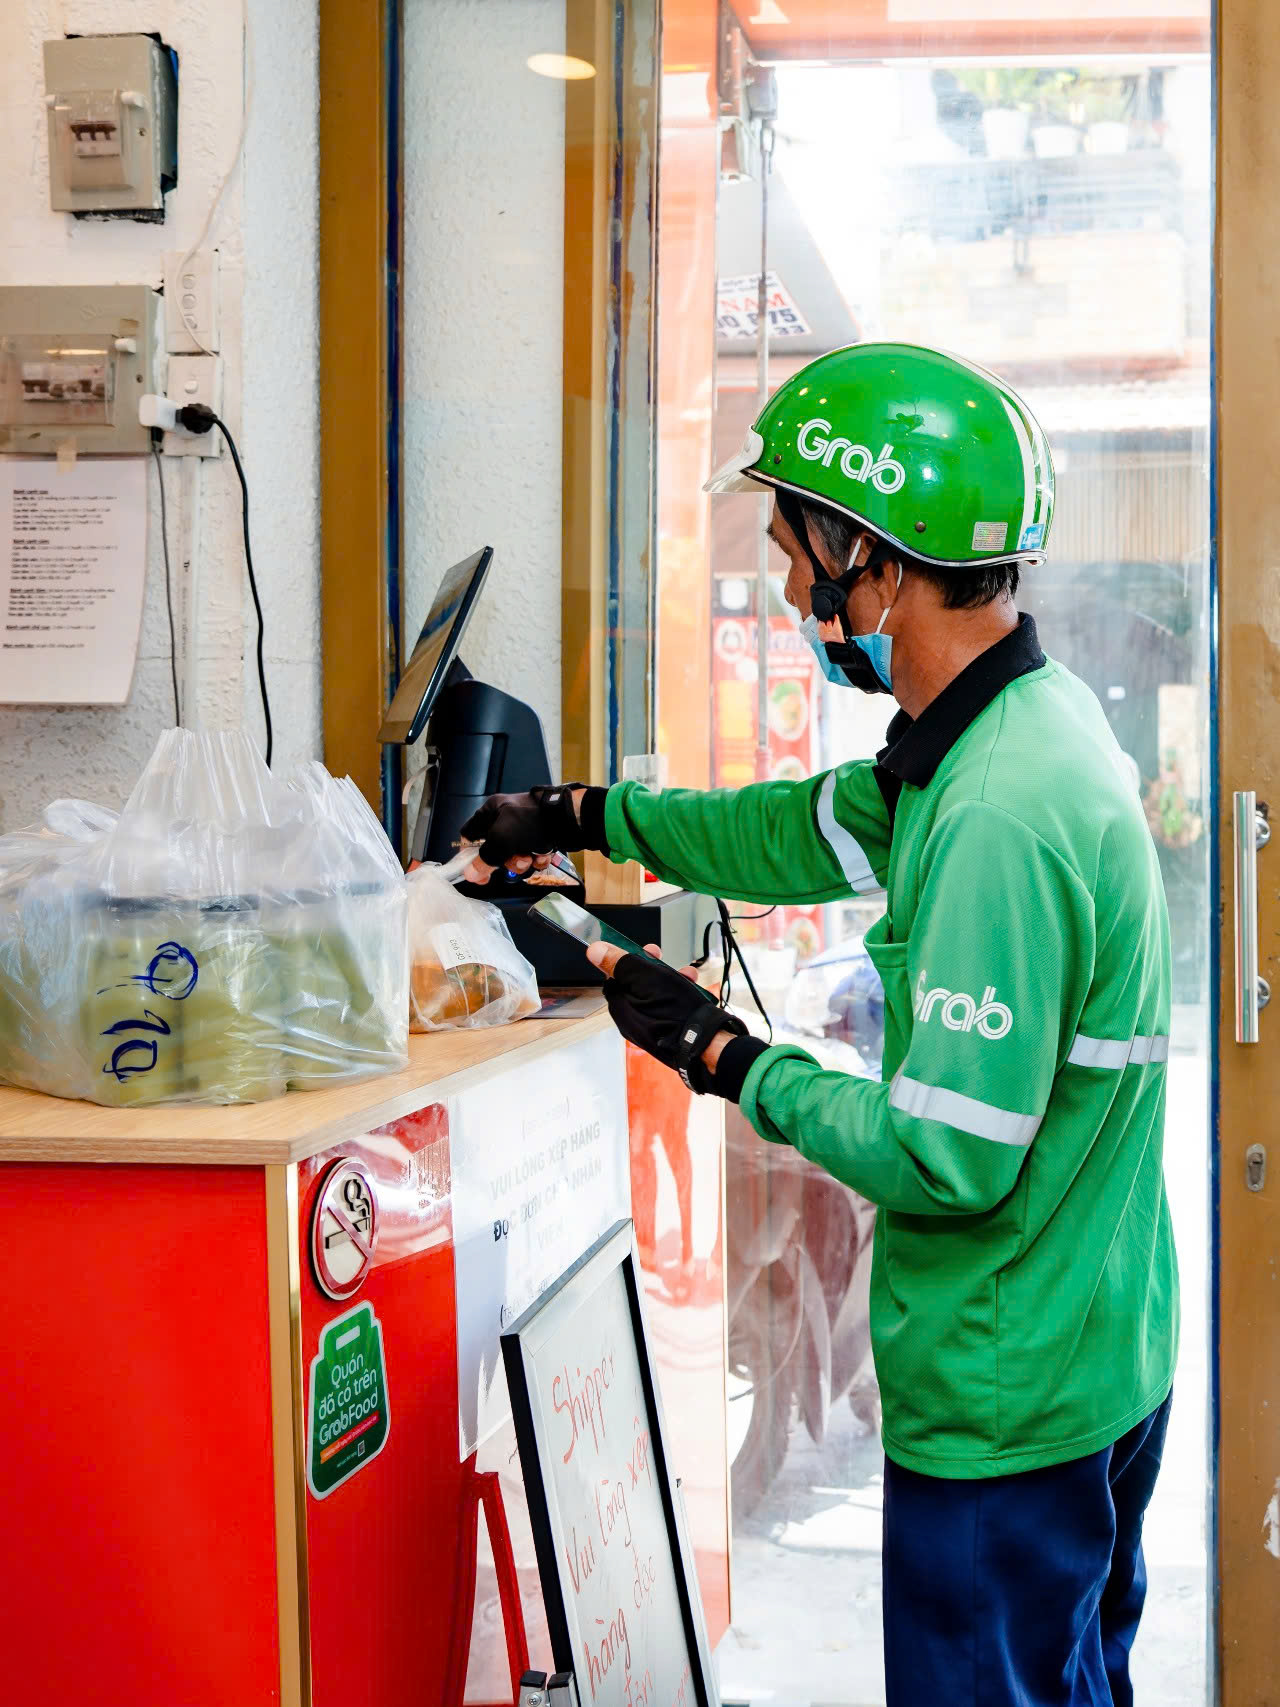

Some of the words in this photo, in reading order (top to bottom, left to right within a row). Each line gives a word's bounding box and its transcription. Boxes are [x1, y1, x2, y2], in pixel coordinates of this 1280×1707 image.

[797, 418, 906, 494] Grab
[318, 1392, 336, 1420] đã
[337, 1380, 352, 1407] có
[353, 1368, 377, 1396] trên
[331, 1352, 364, 1388] Quán
[319, 1386, 378, 1446] GrabFood
[552, 1353, 615, 1464] Shipper
